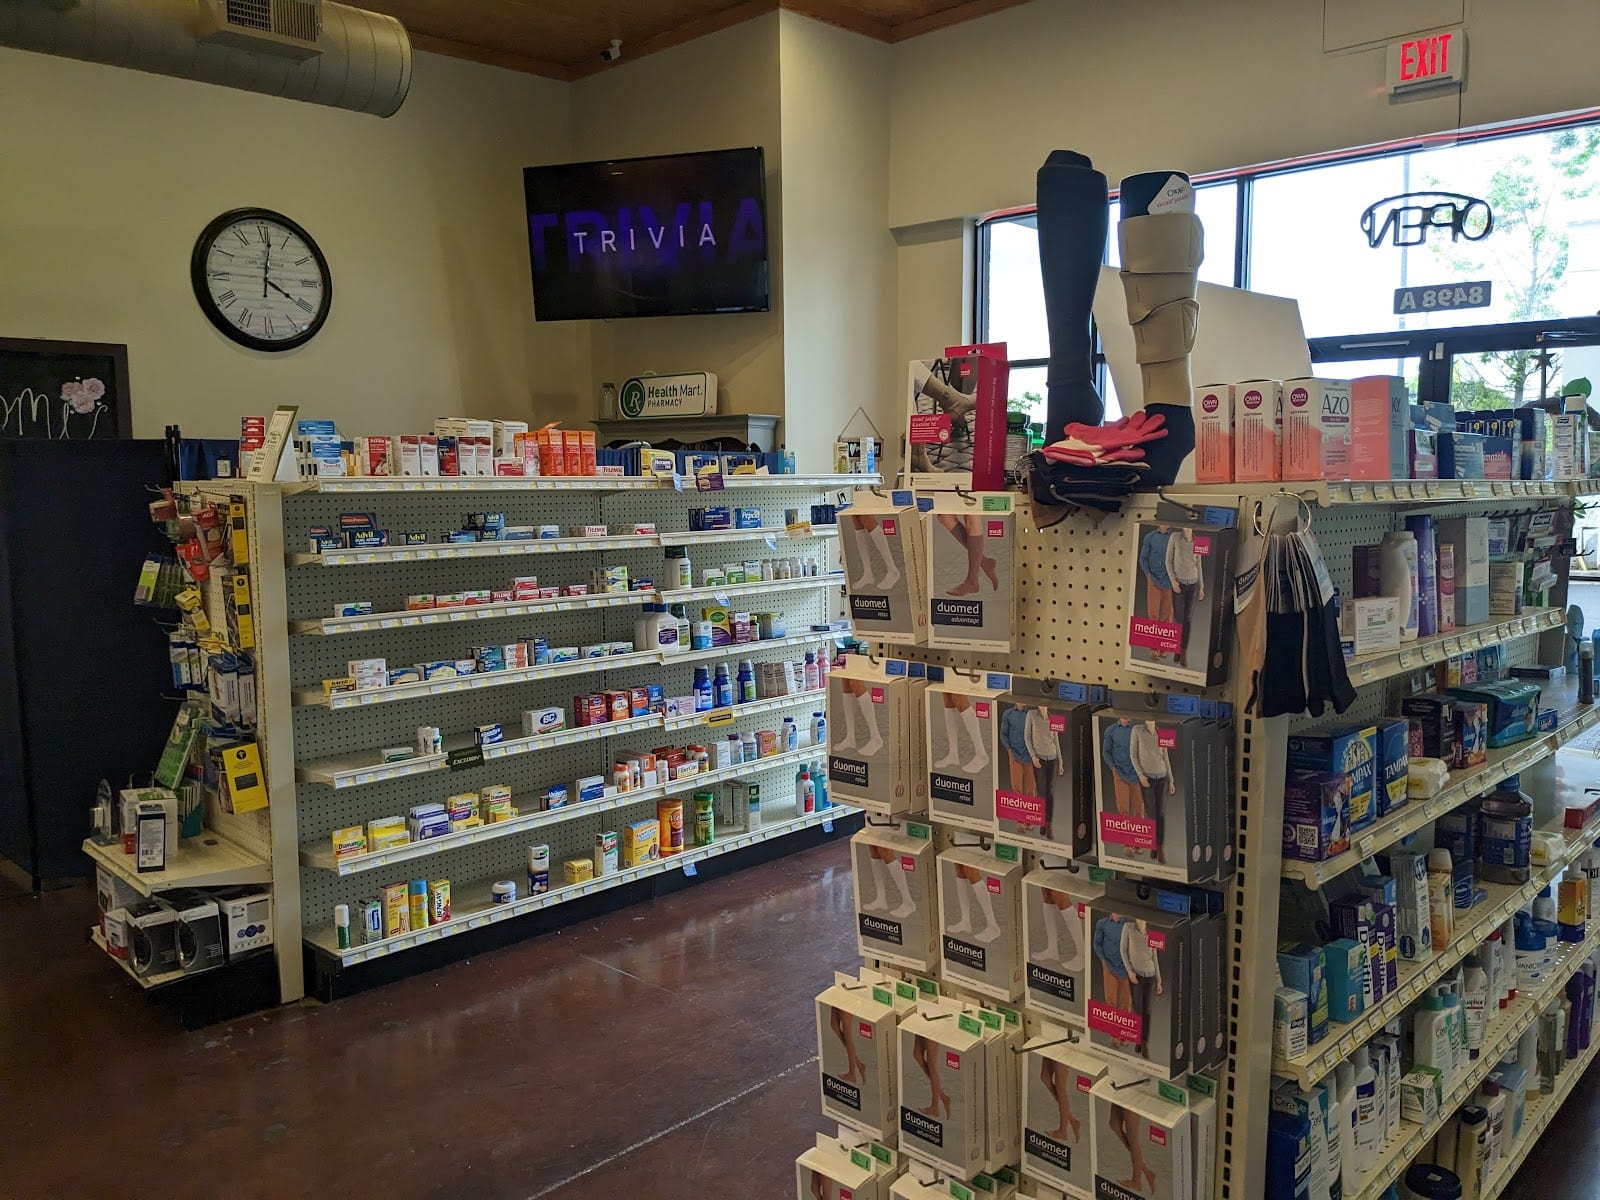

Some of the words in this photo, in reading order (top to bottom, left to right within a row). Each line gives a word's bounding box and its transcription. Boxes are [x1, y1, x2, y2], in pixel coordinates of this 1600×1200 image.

[1400, 33, 1452, 81] EXIT
[573, 223, 716, 254] TRIVIA
[648, 386, 678, 399] Health
[647, 398, 683, 408] PHARMACY
[1321, 394, 1349, 415] AZO
[355, 531, 374, 539] Advil
[408, 533, 426, 541] Advil
[855, 598, 887, 609] duomed
[937, 601, 979, 614] duomed
[1160, 641, 1177, 649] active
[541, 713, 557, 725] BC
[833, 759, 866, 774] duomed
[1351, 763, 1372, 783] MPAX
[935, 777, 971, 793] duomed
[1134, 837, 1152, 845] active
[864, 917, 899, 934] duomed
[948, 939, 983, 959] duomed
[1359, 931, 1371, 995] Desitin
[1032, 967, 1072, 989] duomed
[826, 1077, 858, 1099] duomed
[905, 1111, 940, 1134] duomed
[1029, 1133, 1068, 1158] duomed
